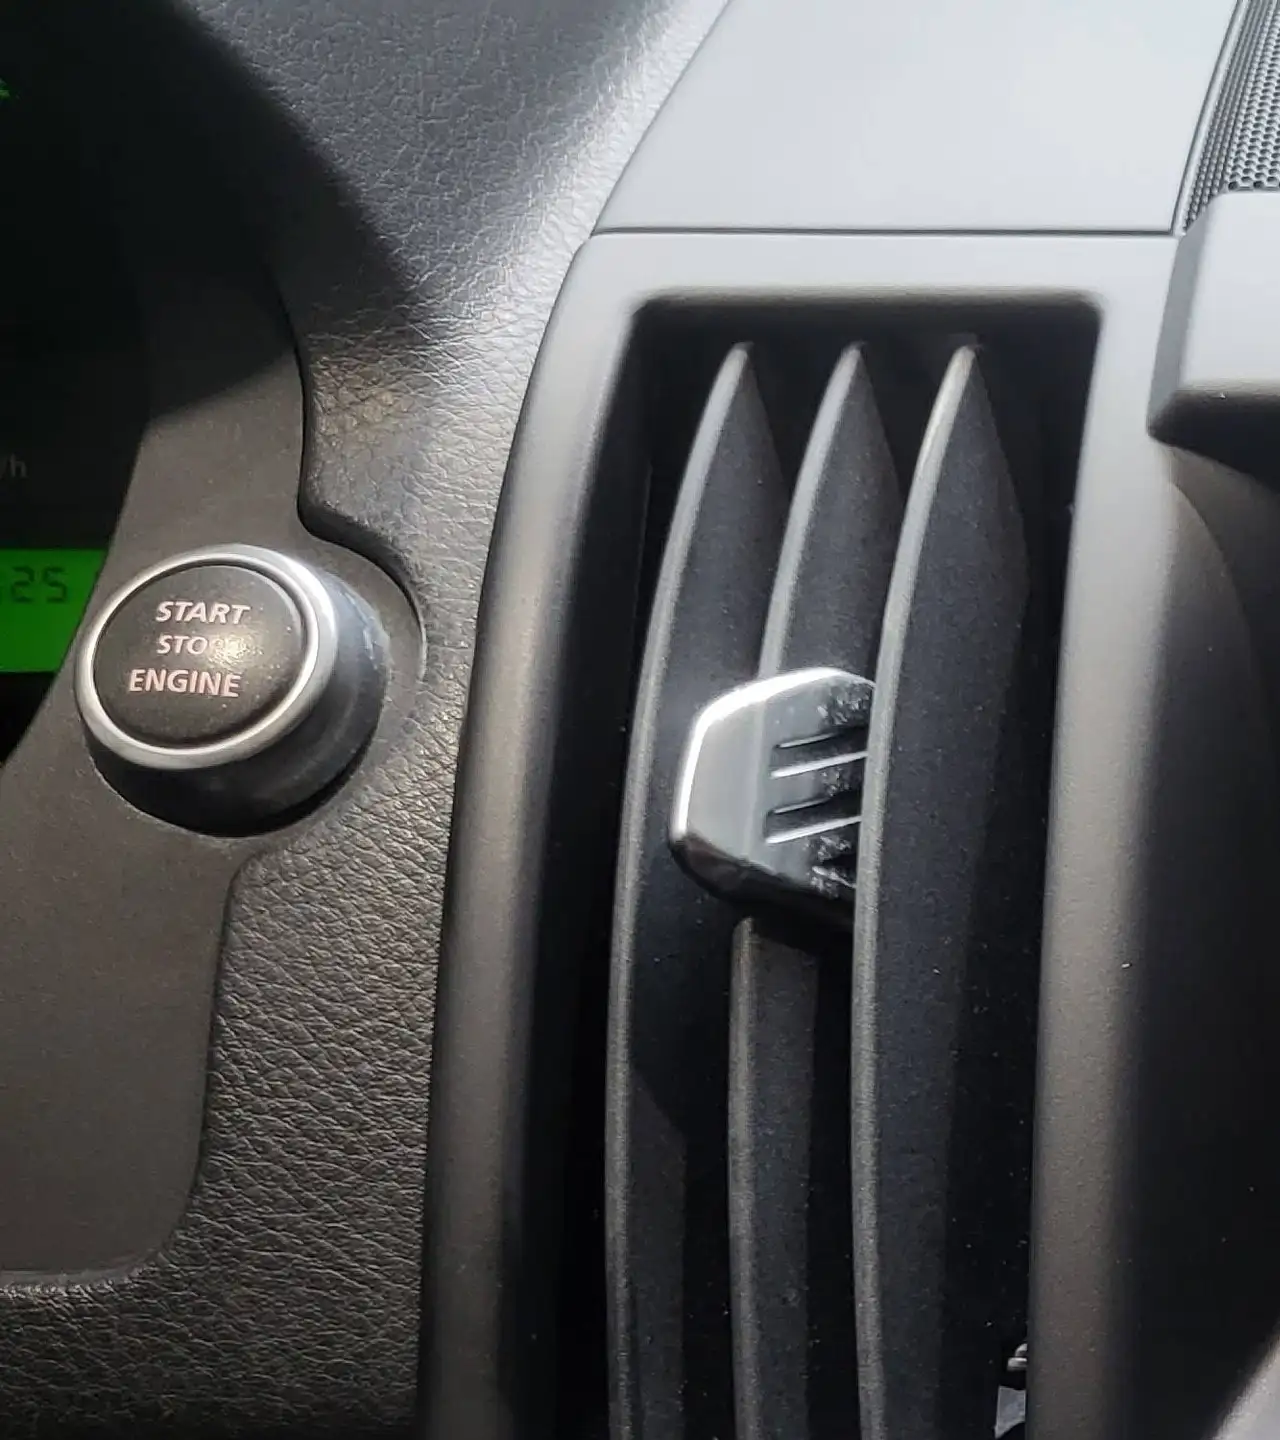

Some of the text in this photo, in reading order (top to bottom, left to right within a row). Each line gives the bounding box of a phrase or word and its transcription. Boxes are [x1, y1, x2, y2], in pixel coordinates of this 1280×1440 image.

[0, 564, 68, 603] 25
[156, 601, 251, 625] START
[129, 669, 242, 698] ENGINE
